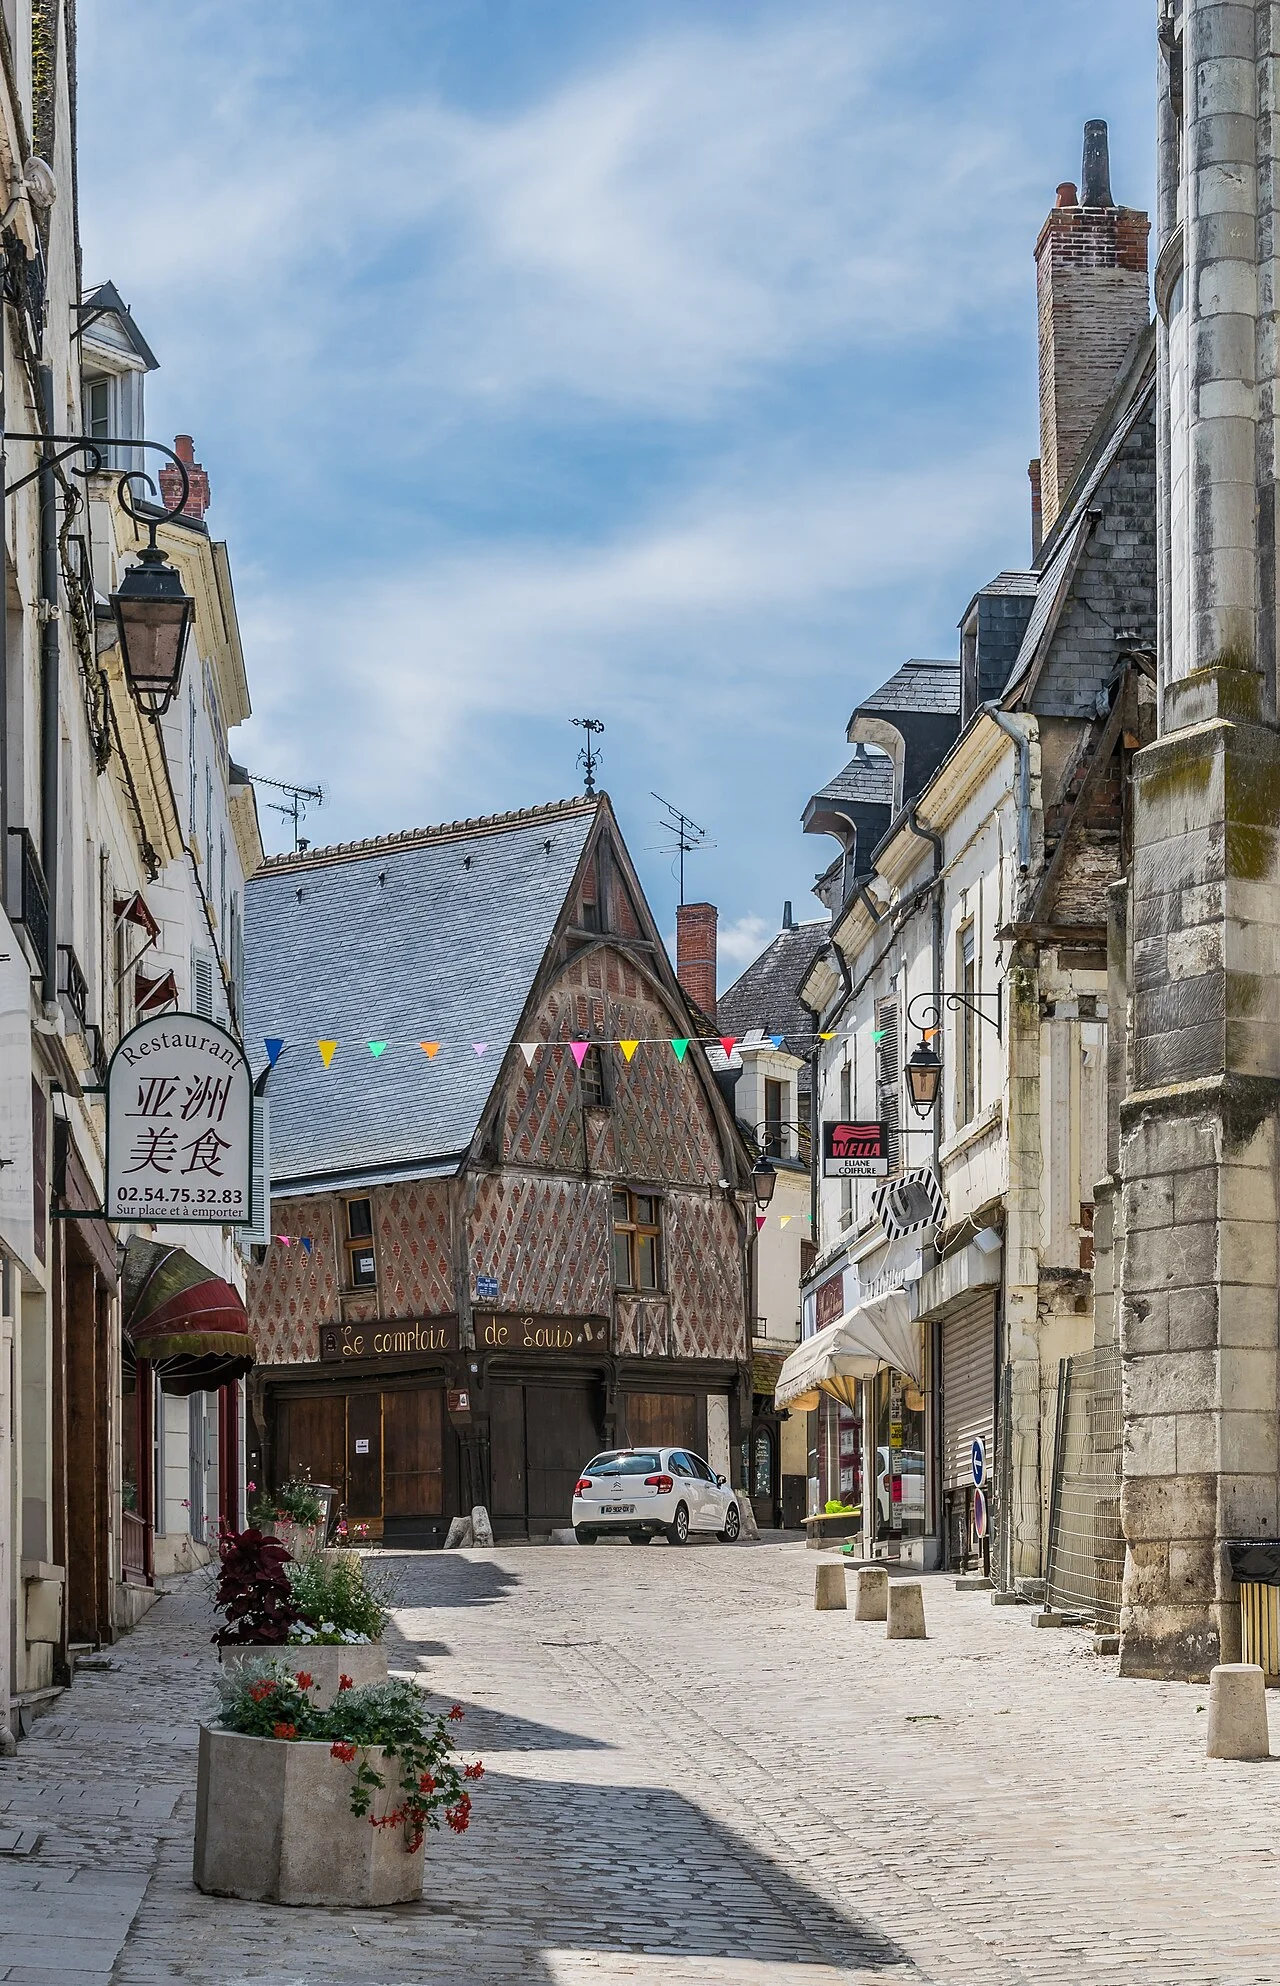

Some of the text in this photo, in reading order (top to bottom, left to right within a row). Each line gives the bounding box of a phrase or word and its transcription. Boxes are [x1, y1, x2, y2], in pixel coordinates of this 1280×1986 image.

[119, 1032, 244, 1072] Restaurant
[124, 1074, 234, 1122] 亚洲
[121, 1126, 233, 1177] 美食
[832, 1142, 881, 1157] WELLA
[838, 1167, 877, 1175] COIFFURE
[116, 1203, 244, 1219] Sur place et à emporter
[117, 1186, 243, 1204] 02.54.75.32.83
[340, 1322, 451, 1356] Le comptoir
[484, 1315, 573, 1348] de Louis
